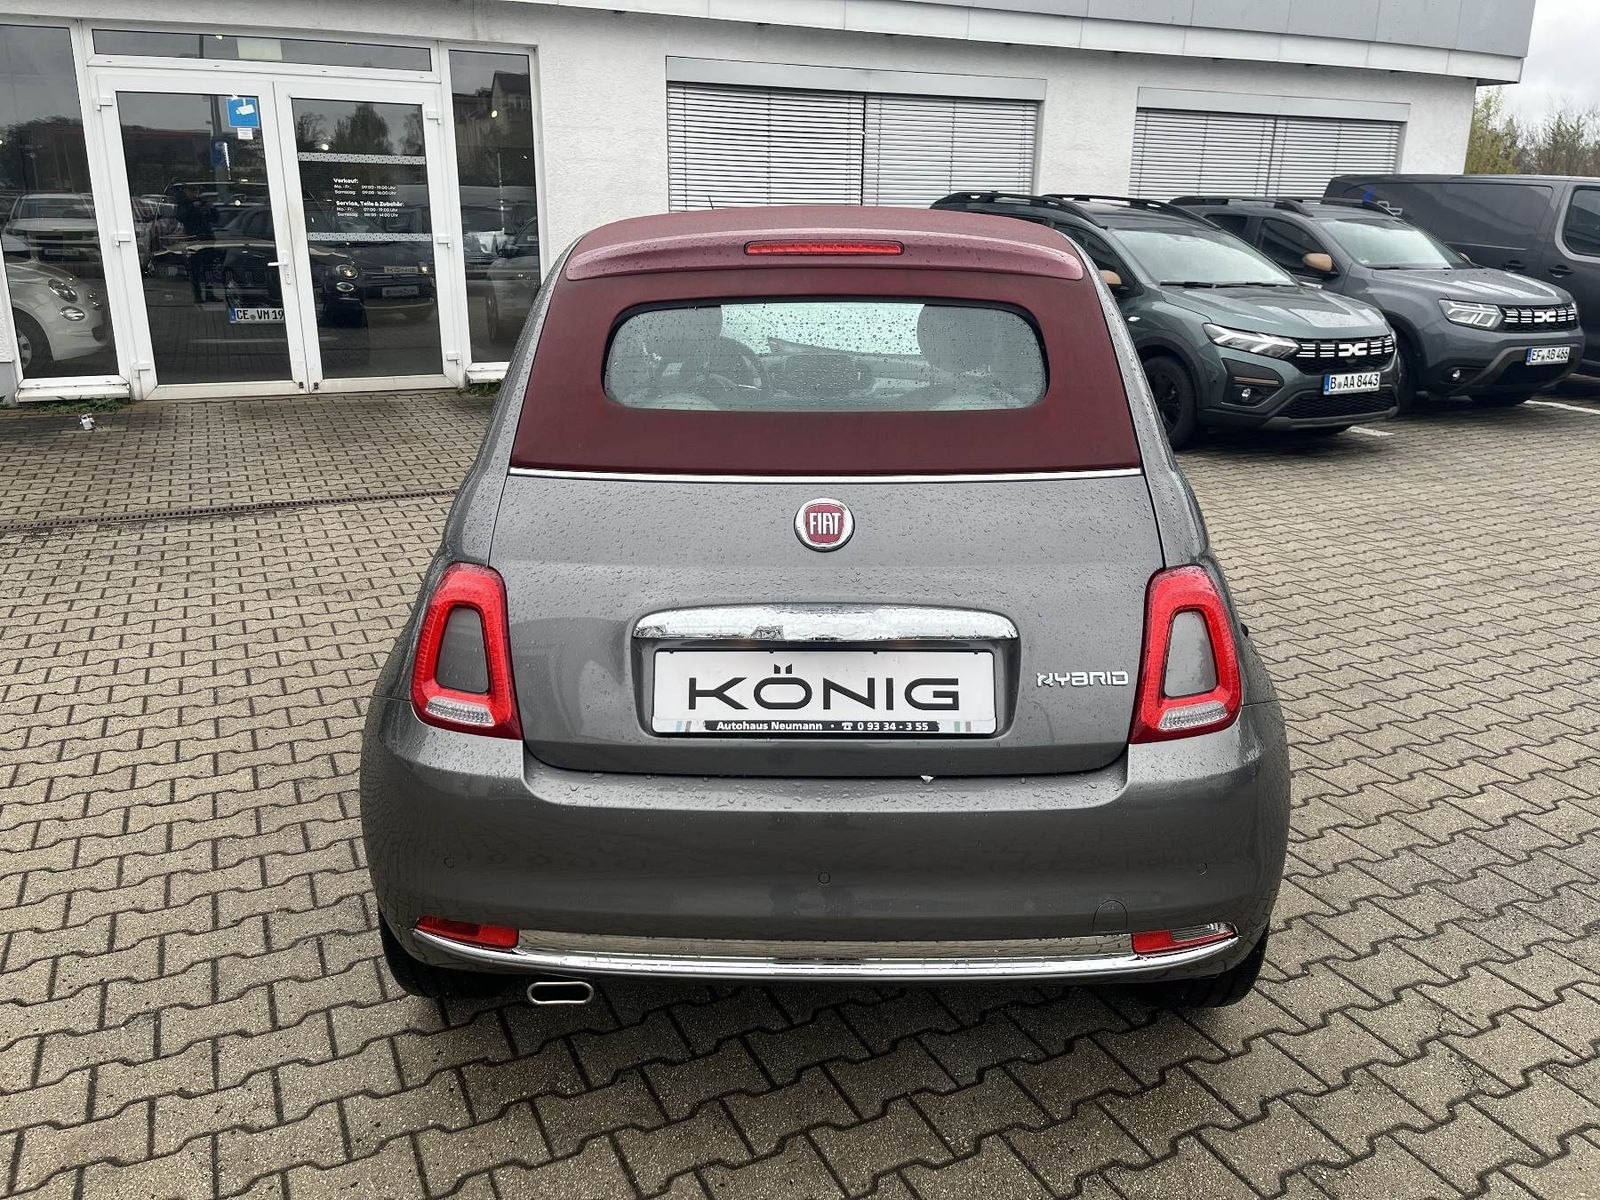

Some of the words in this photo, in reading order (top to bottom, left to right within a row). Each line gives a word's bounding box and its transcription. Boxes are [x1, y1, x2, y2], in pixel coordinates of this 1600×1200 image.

[236, 310, 249, 320] CE
[256, 310, 270, 320] VM
[1330, 377, 1336, 389] B
[1343, 376, 1354, 388] AA
[1356, 374, 1379, 387] 8443
[810, 512, 842, 535] FIAT
[1036, 671, 1129, 687] HYBRID
[688, 663, 960, 711] KÖNIG
[716, 720, 768, 730] Autohaus
[770, 720, 823, 730] Neumann
